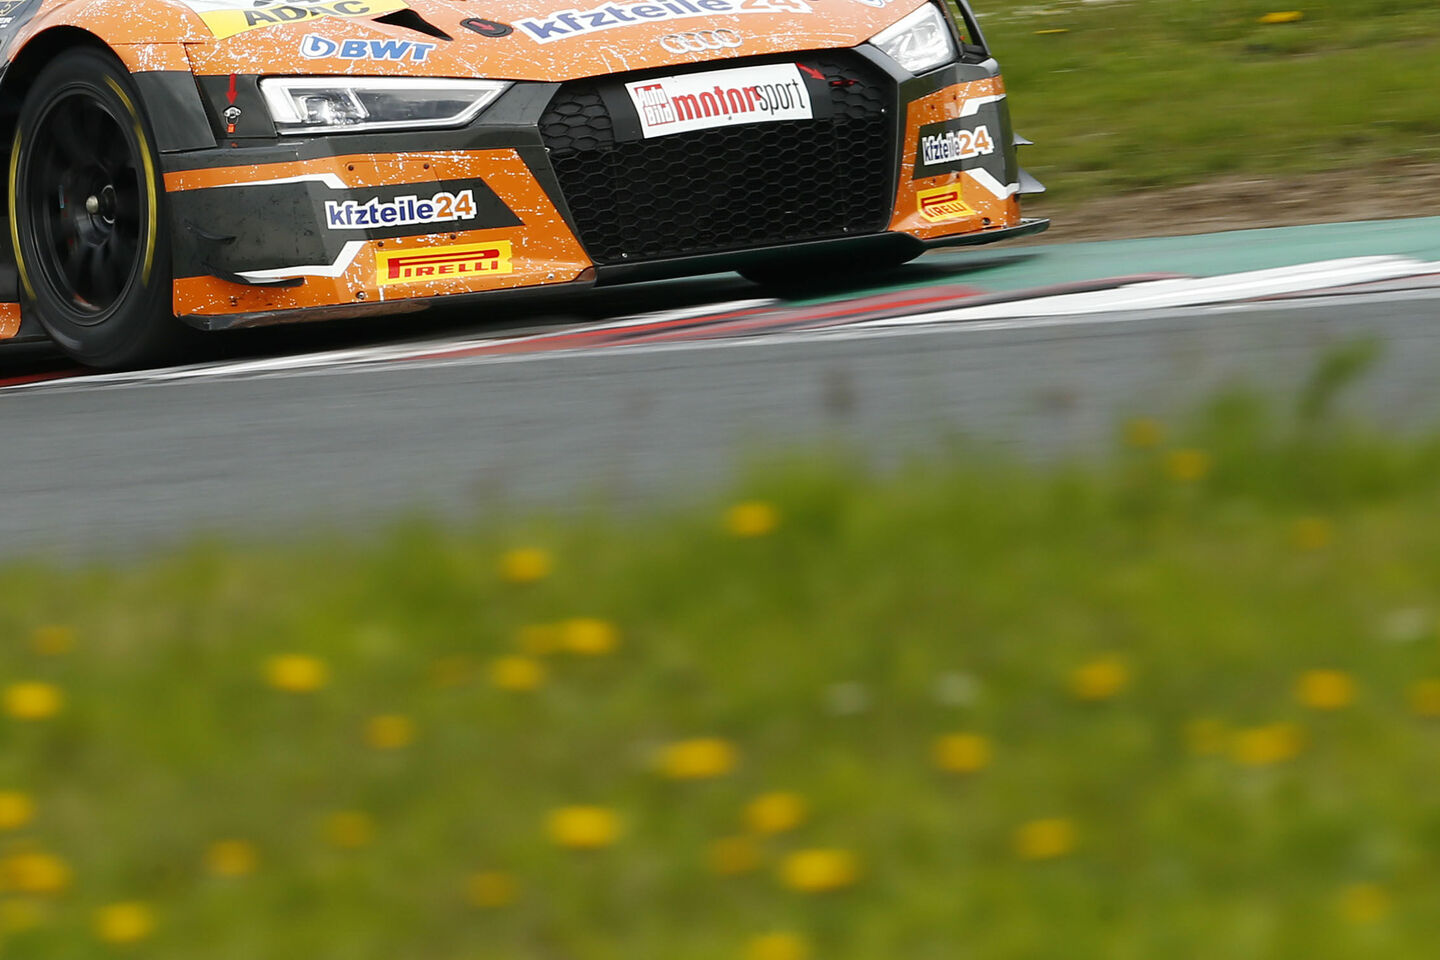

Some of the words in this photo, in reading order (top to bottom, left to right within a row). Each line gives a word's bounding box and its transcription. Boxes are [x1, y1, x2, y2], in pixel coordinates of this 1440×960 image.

[340, 38, 437, 62] BWT
[328, 192, 474, 227] kfzteile24
[921, 191, 968, 218] PIRELLI
[387, 248, 500, 280] PIRELLI
